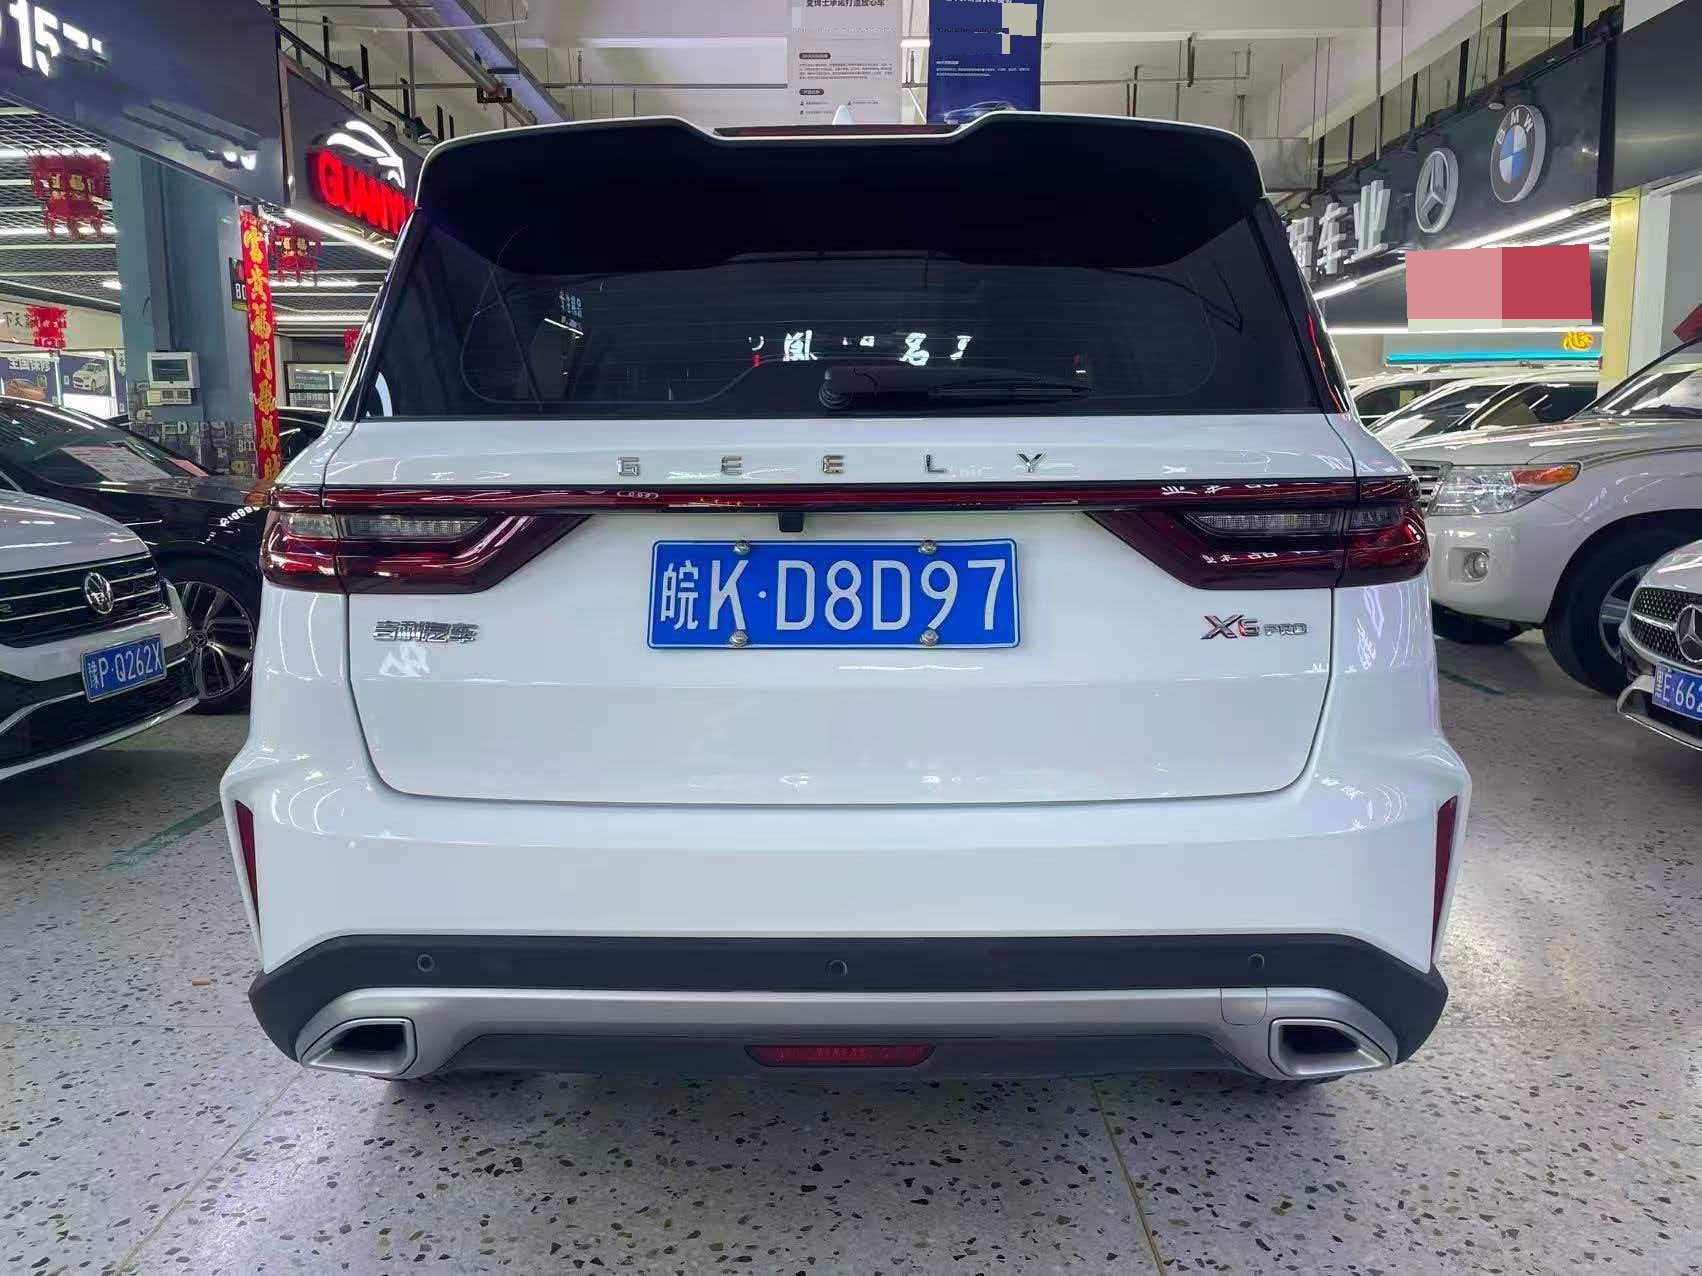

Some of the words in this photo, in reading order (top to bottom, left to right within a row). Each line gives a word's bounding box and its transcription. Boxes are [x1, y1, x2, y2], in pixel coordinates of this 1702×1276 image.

[616, 452, 1048, 478] GEELY
[660, 559, 1006, 631] 皖K·D8D97
[1263, 622, 1307, 636] PRO
